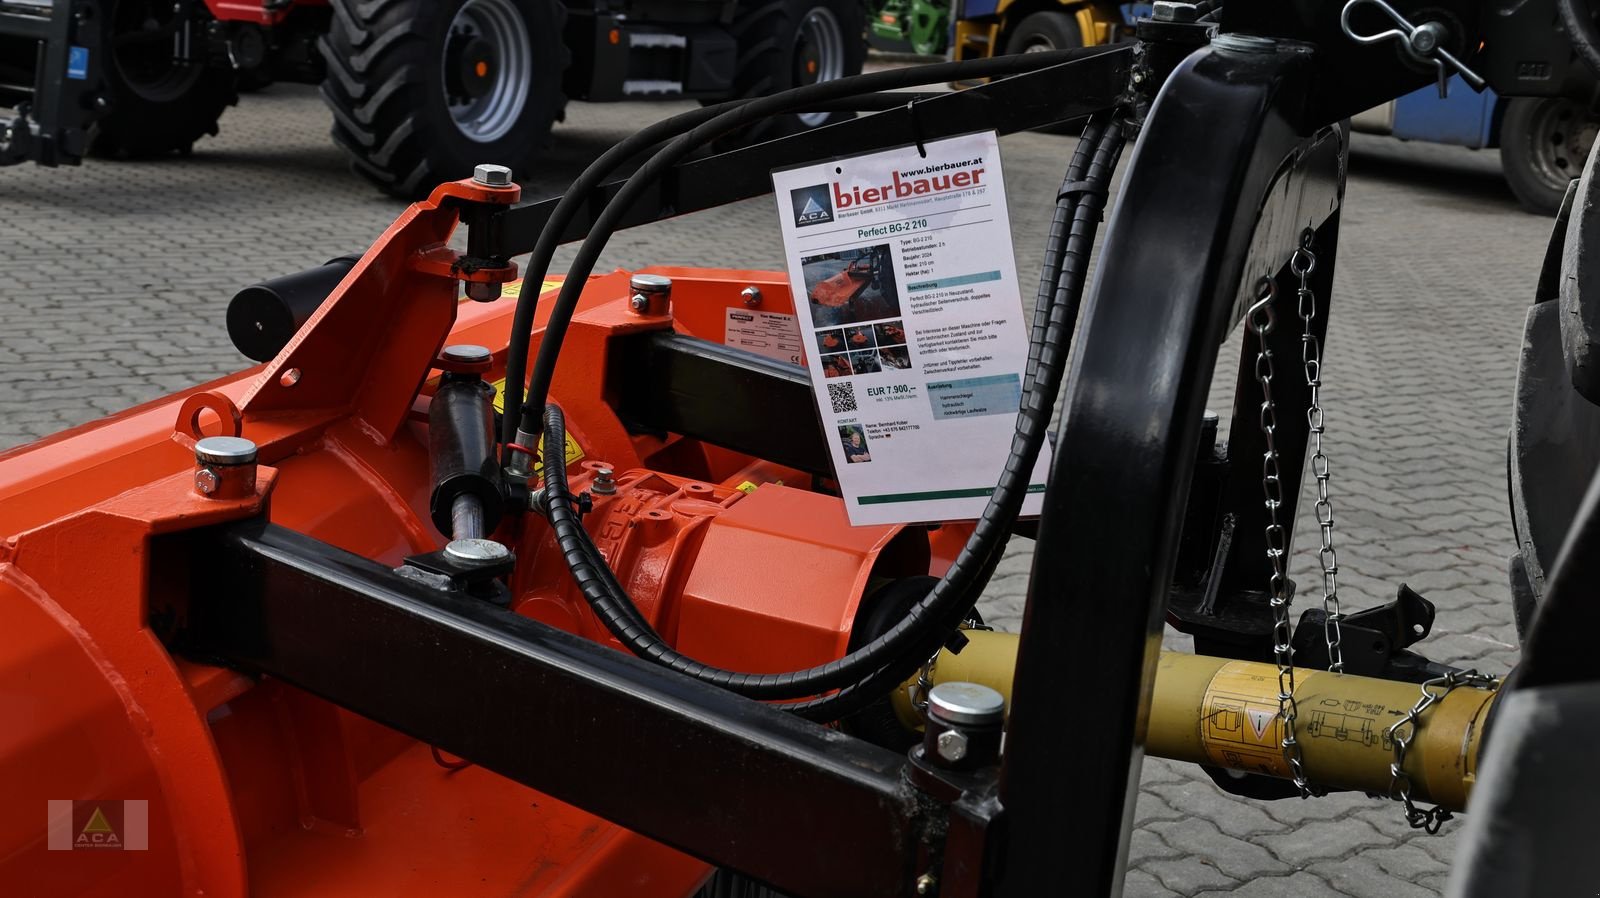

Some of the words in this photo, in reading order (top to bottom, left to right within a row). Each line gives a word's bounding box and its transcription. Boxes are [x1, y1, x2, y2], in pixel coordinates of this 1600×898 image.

[900, 158, 982, 178] www.bierbauer.at
[832, 168, 984, 209] bierbauer
[798, 211, 829, 222] ACA
[858, 224, 888, 238] Perfect
[889, 220, 910, 232] BG-2
[912, 218, 928, 229] 210
[908, 282, 938, 290] Beschreibung
[867, 387, 886, 396] EUR
